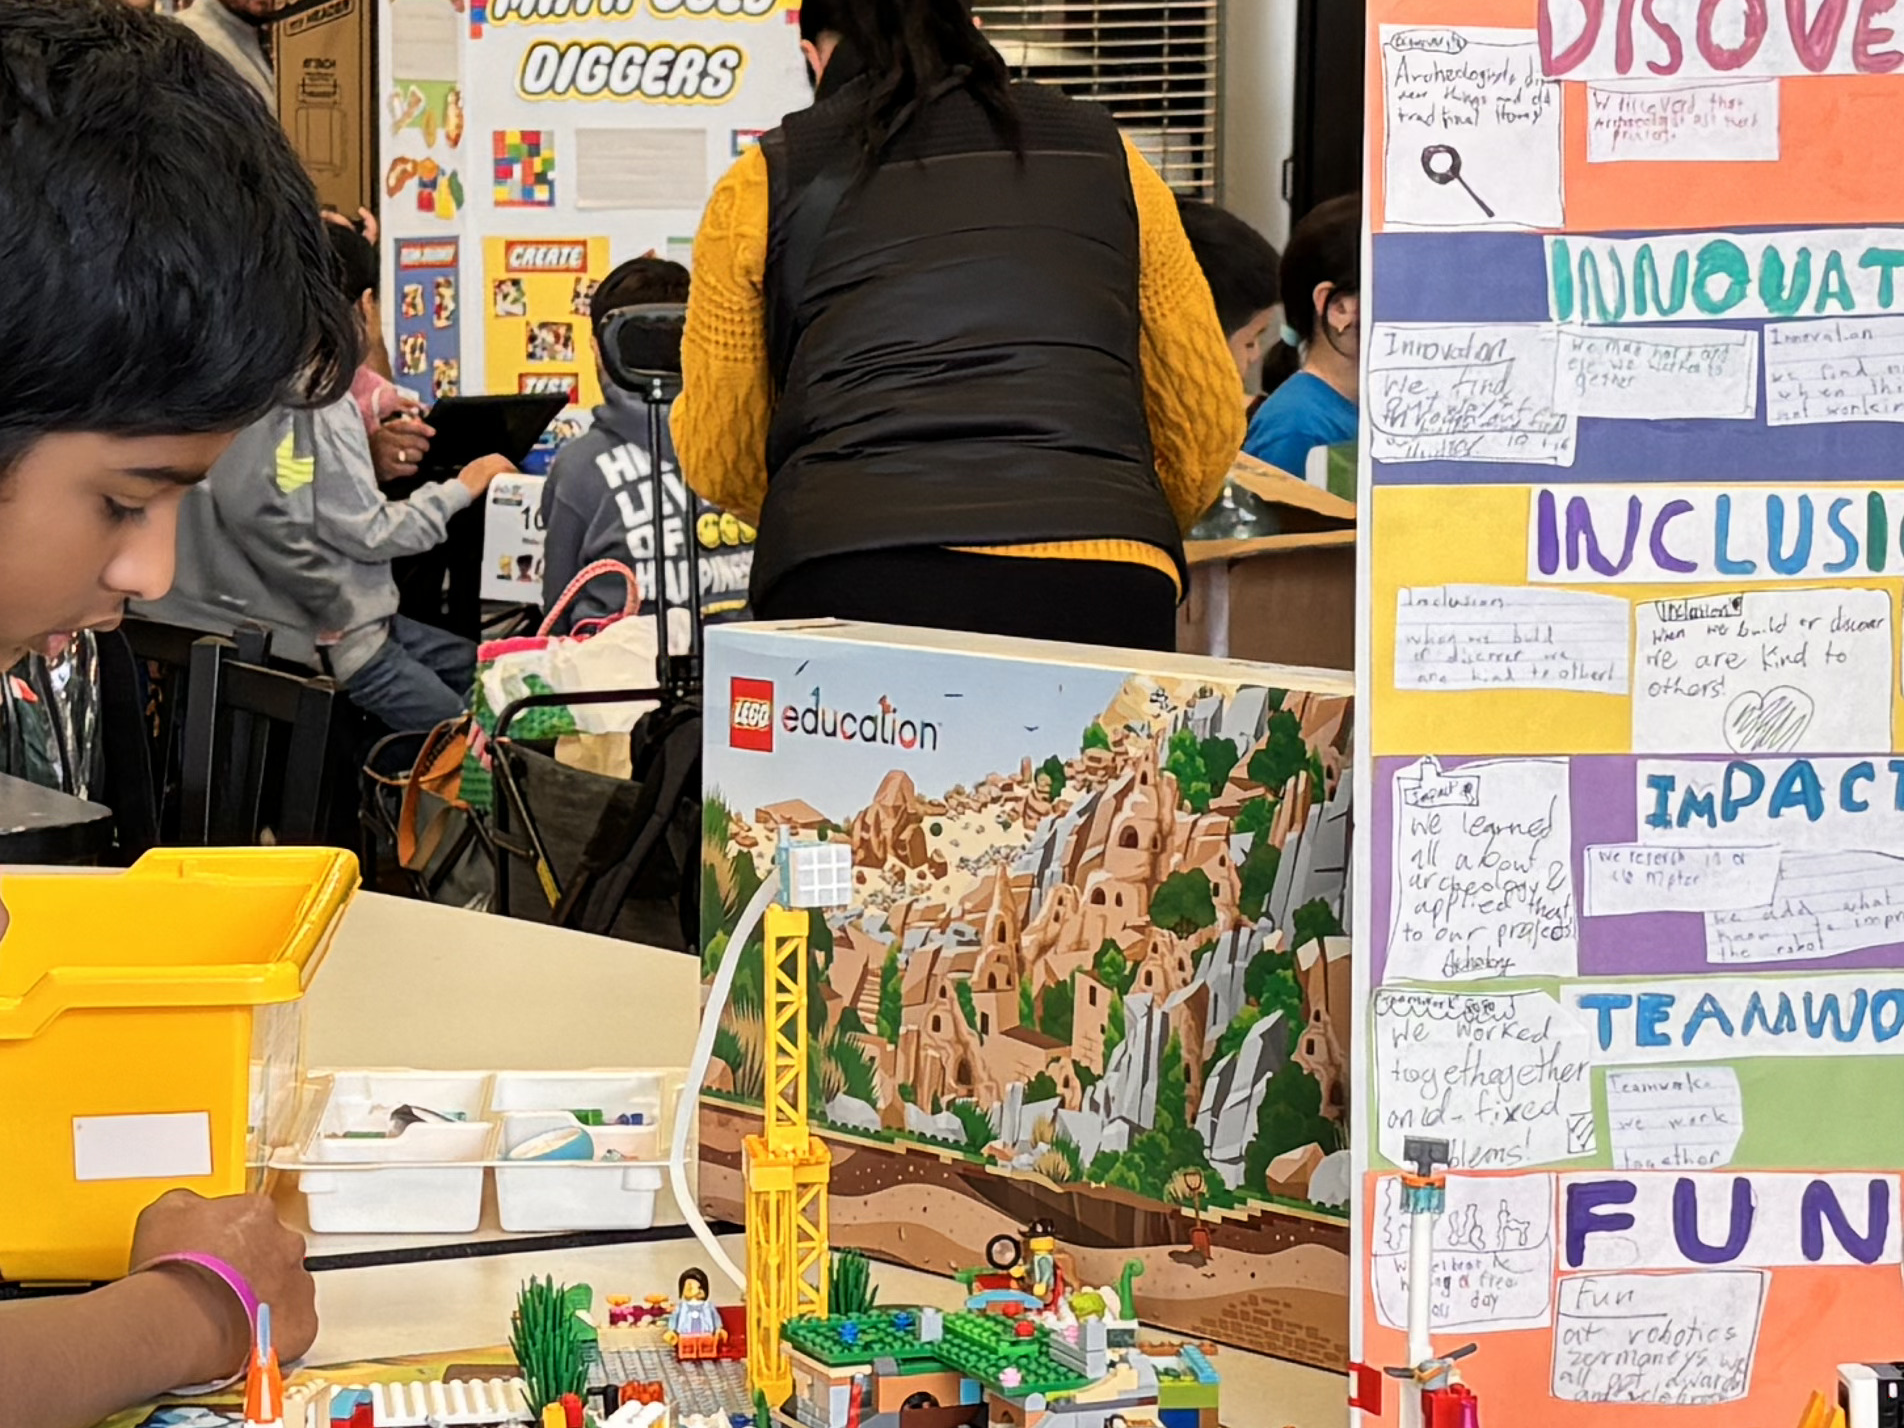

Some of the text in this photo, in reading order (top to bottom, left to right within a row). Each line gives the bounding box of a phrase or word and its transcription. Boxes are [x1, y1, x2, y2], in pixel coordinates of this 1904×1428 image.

[522, 43, 741, 99] DIGGERS
[509, 243, 583, 269] CREATE
[626, 517, 685, 558] OF
[733, 686, 937, 751] LEGO education
[1565, 1177, 1891, 1267] FUN
[1576, 1279, 1634, 1310] Fun
